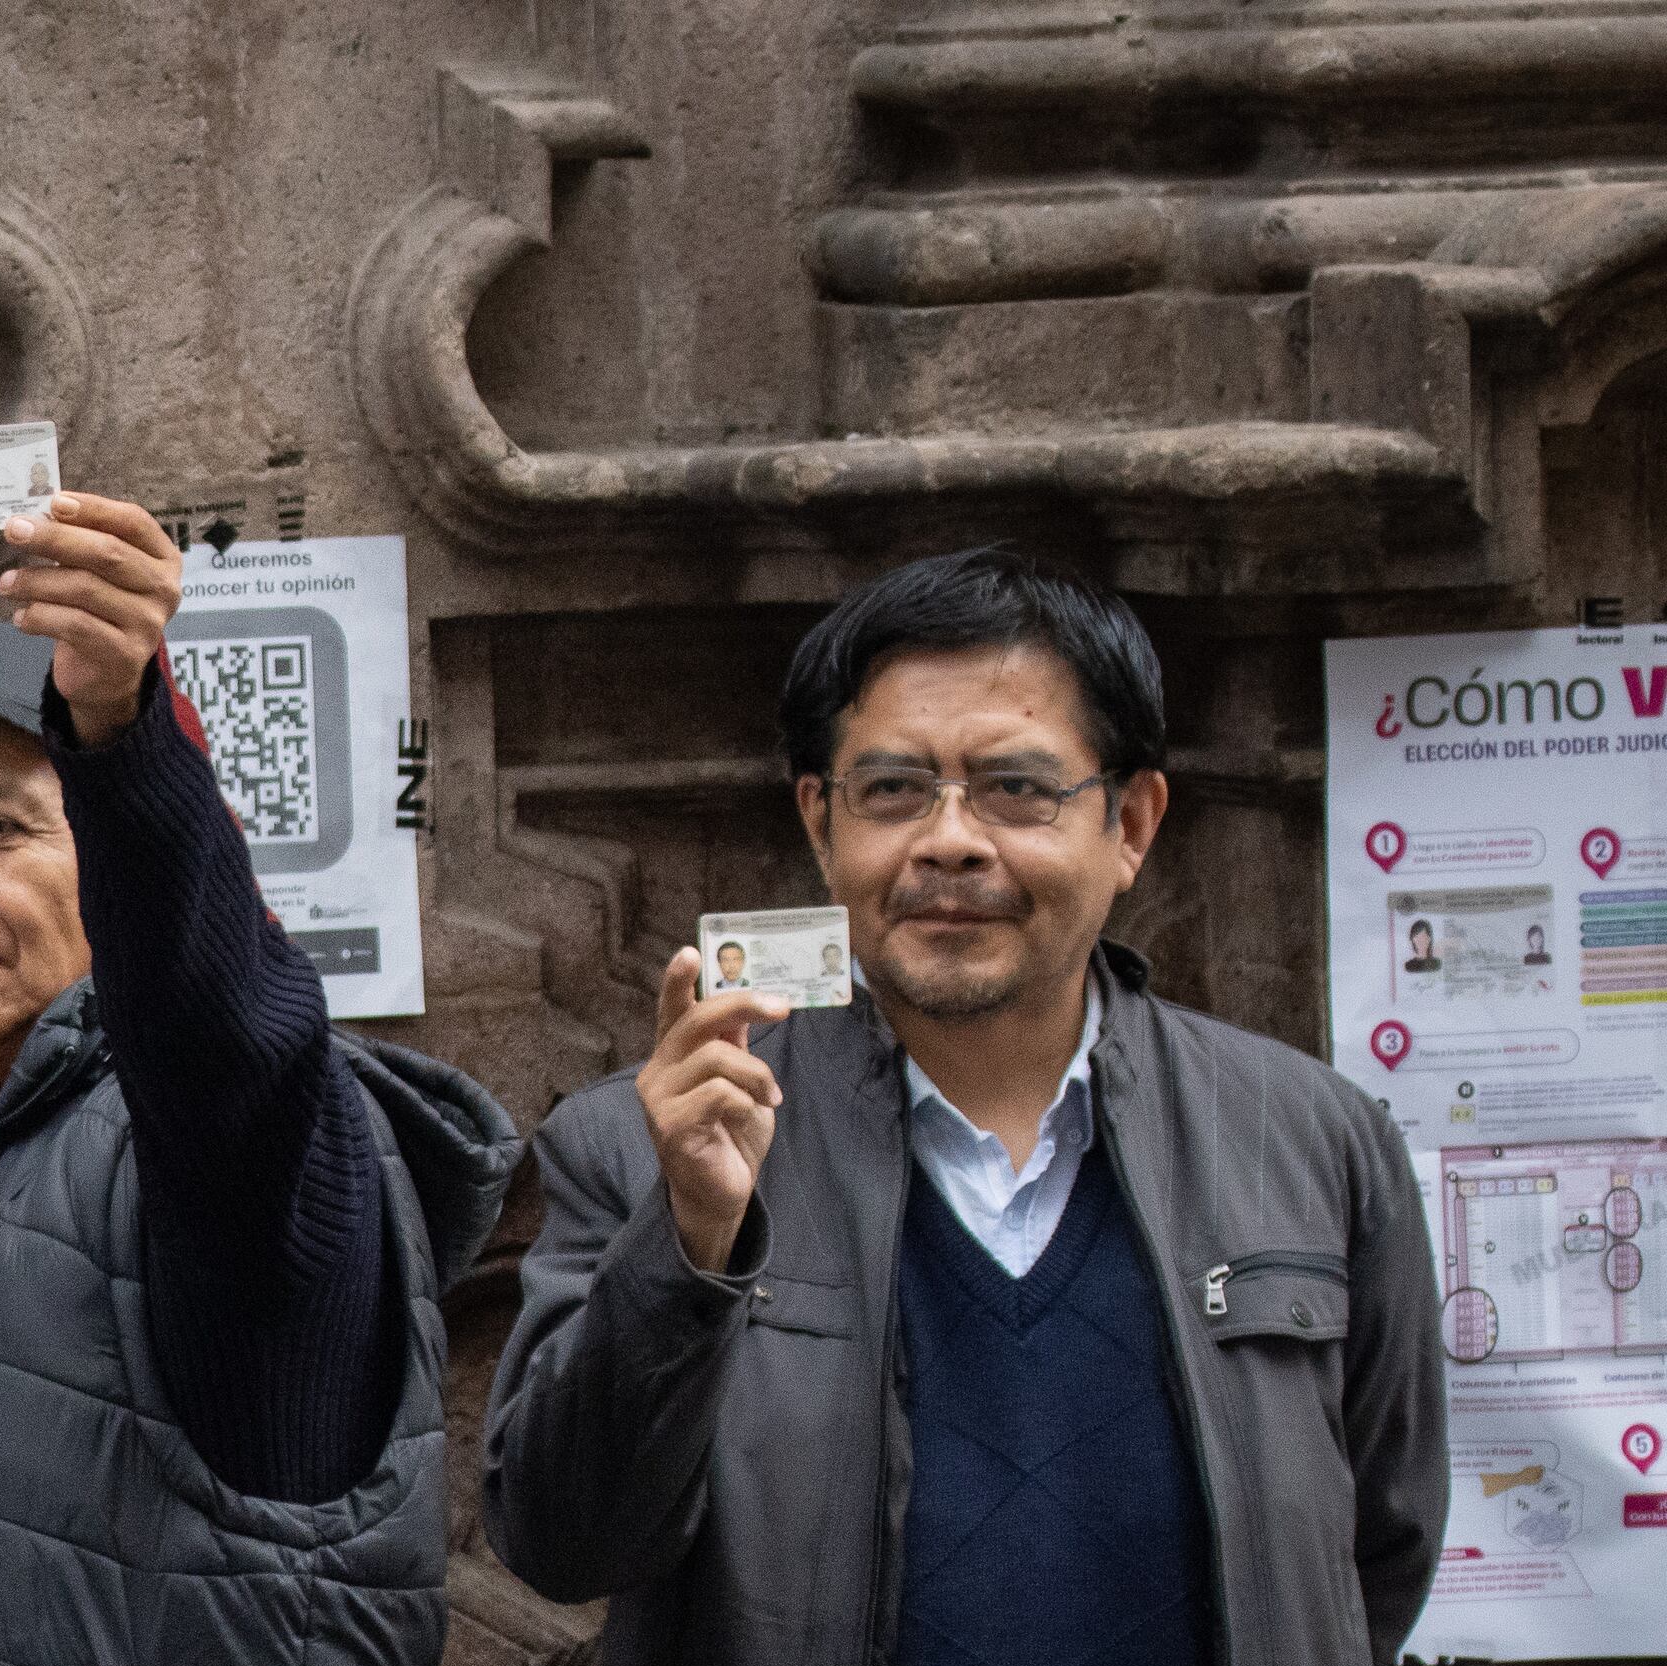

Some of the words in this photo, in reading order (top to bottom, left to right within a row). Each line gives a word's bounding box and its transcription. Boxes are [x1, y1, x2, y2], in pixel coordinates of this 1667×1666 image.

[211, 552, 313, 570] Queremos
[255, 579, 275, 593] tu
[281, 573, 355, 594] opinión
[1374, 666, 1605, 740] ¿Cómo
[1404, 736, 1500, 764] ELECCIÓN
[1504, 738, 1540, 759] DEL
[1544, 734, 1610, 758] PODER
[396, 717, 428, 829] INE
[1595, 839, 1607, 859] 2
[1385, 1032, 1398, 1051] 3
[1635, 1436, 1648, 1454] 5
